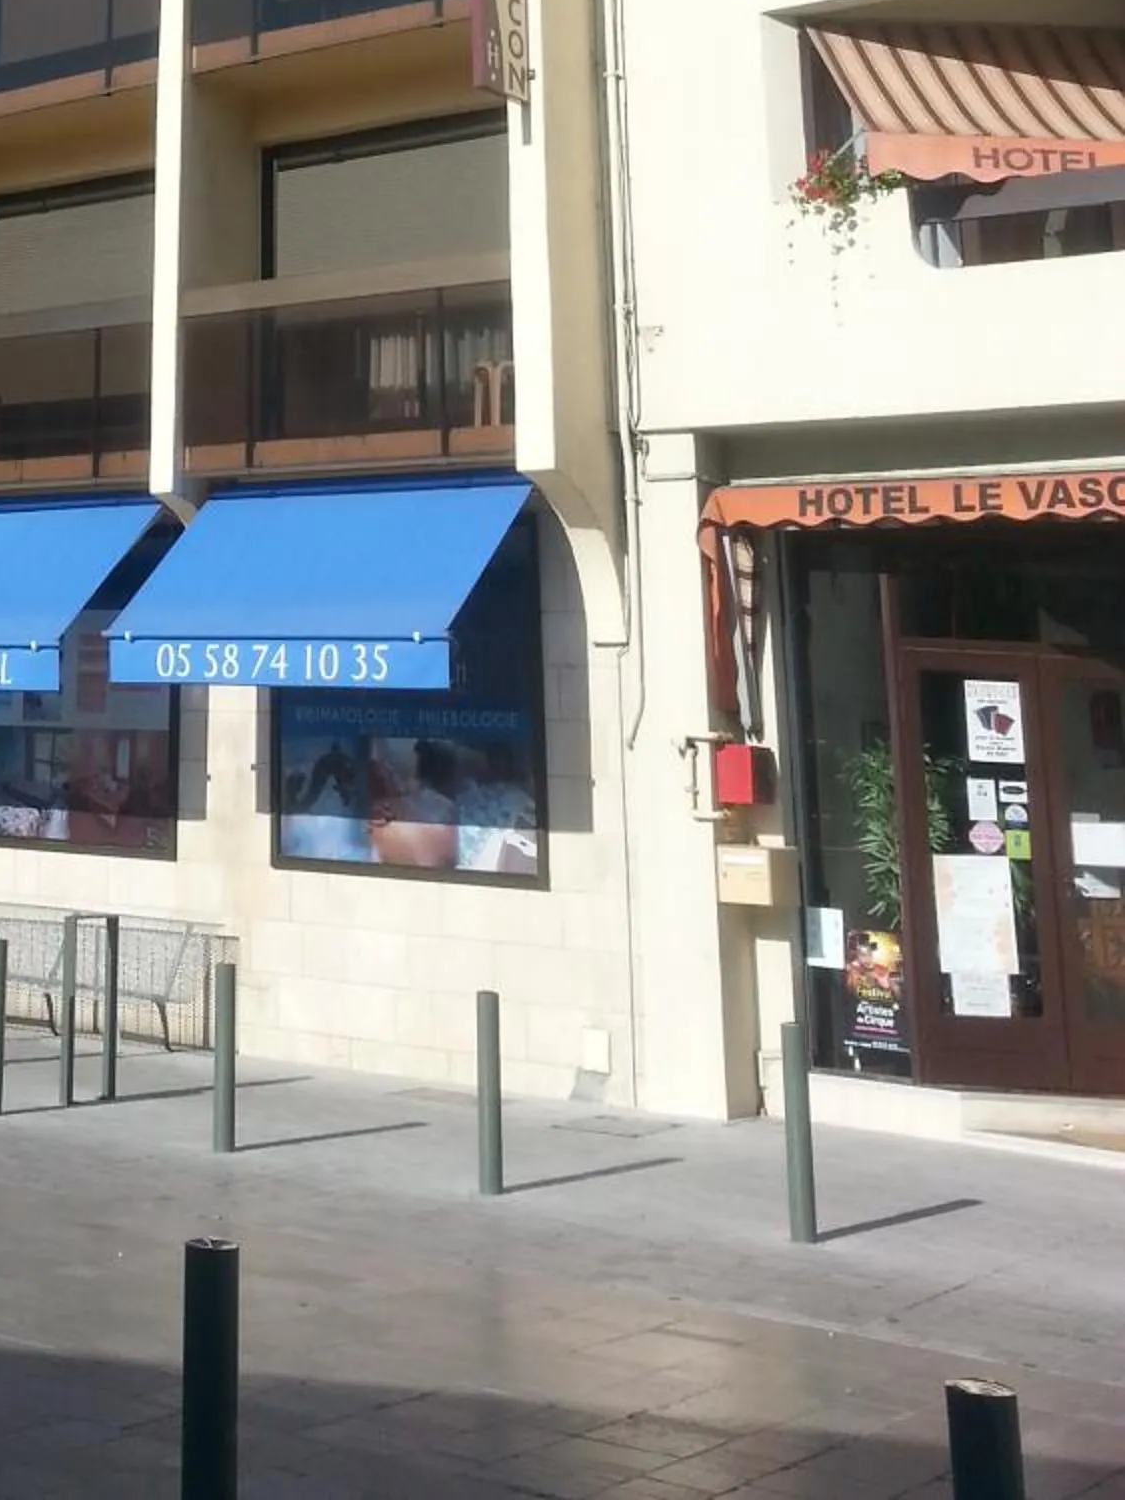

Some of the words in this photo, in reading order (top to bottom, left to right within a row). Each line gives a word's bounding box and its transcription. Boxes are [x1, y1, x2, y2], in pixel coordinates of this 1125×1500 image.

[797, 486, 930, 517] HOTEL
[953, 482, 1003, 512] LE
[156, 643, 192, 678] 05
[203, 643, 240, 679] 58
[250, 643, 289, 680] 74
[303, 643, 340, 681] 10
[350, 643, 390, 681] 35
